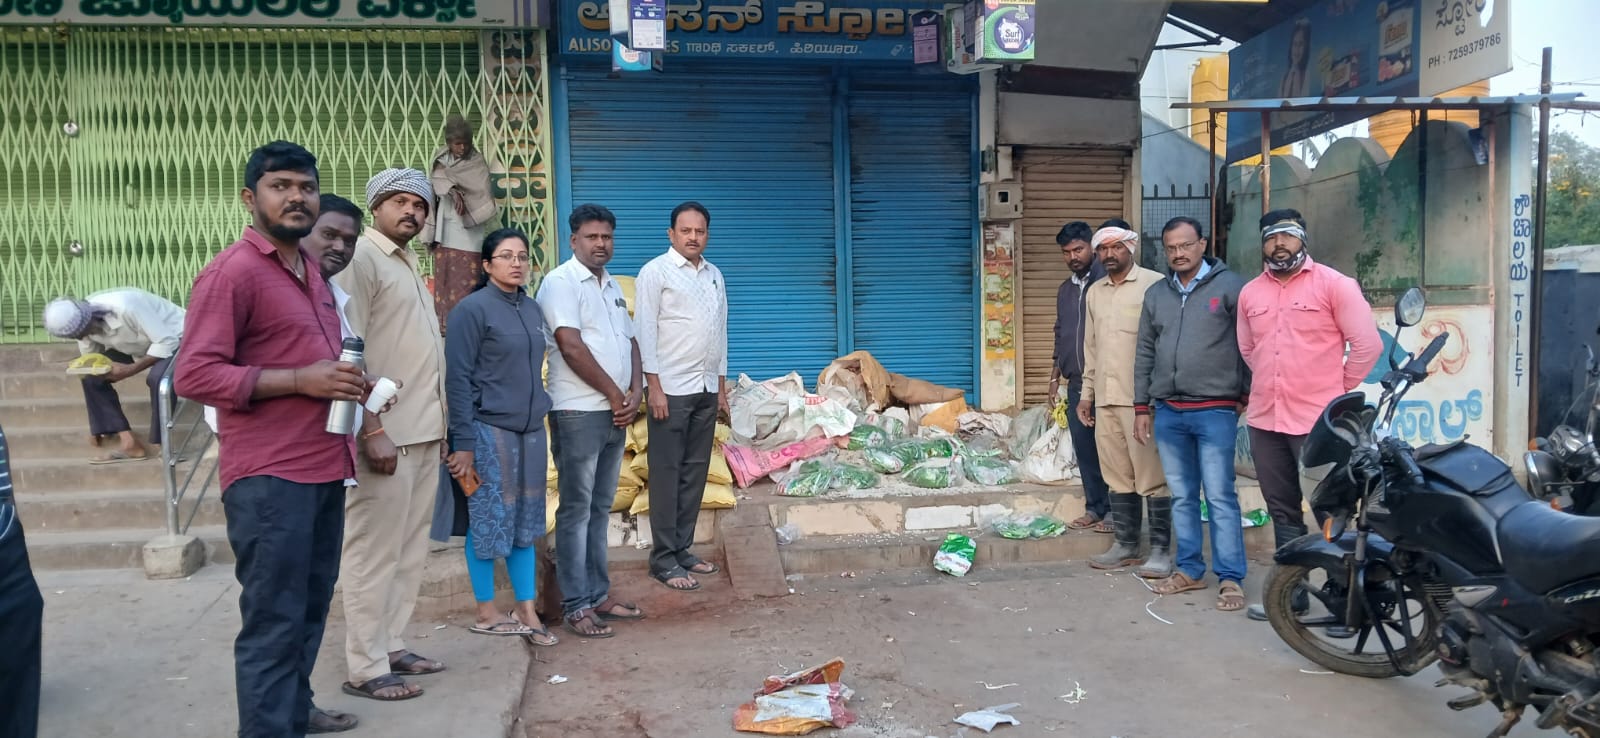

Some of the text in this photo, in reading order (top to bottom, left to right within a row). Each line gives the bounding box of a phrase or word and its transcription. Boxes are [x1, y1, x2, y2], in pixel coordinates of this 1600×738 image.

[1005, 29, 1020, 38] Surf
[1428, 55, 1441, 68] PH
[1447, 33, 1502, 61] 7259379786
[1513, 294, 1525, 387] TOILET
